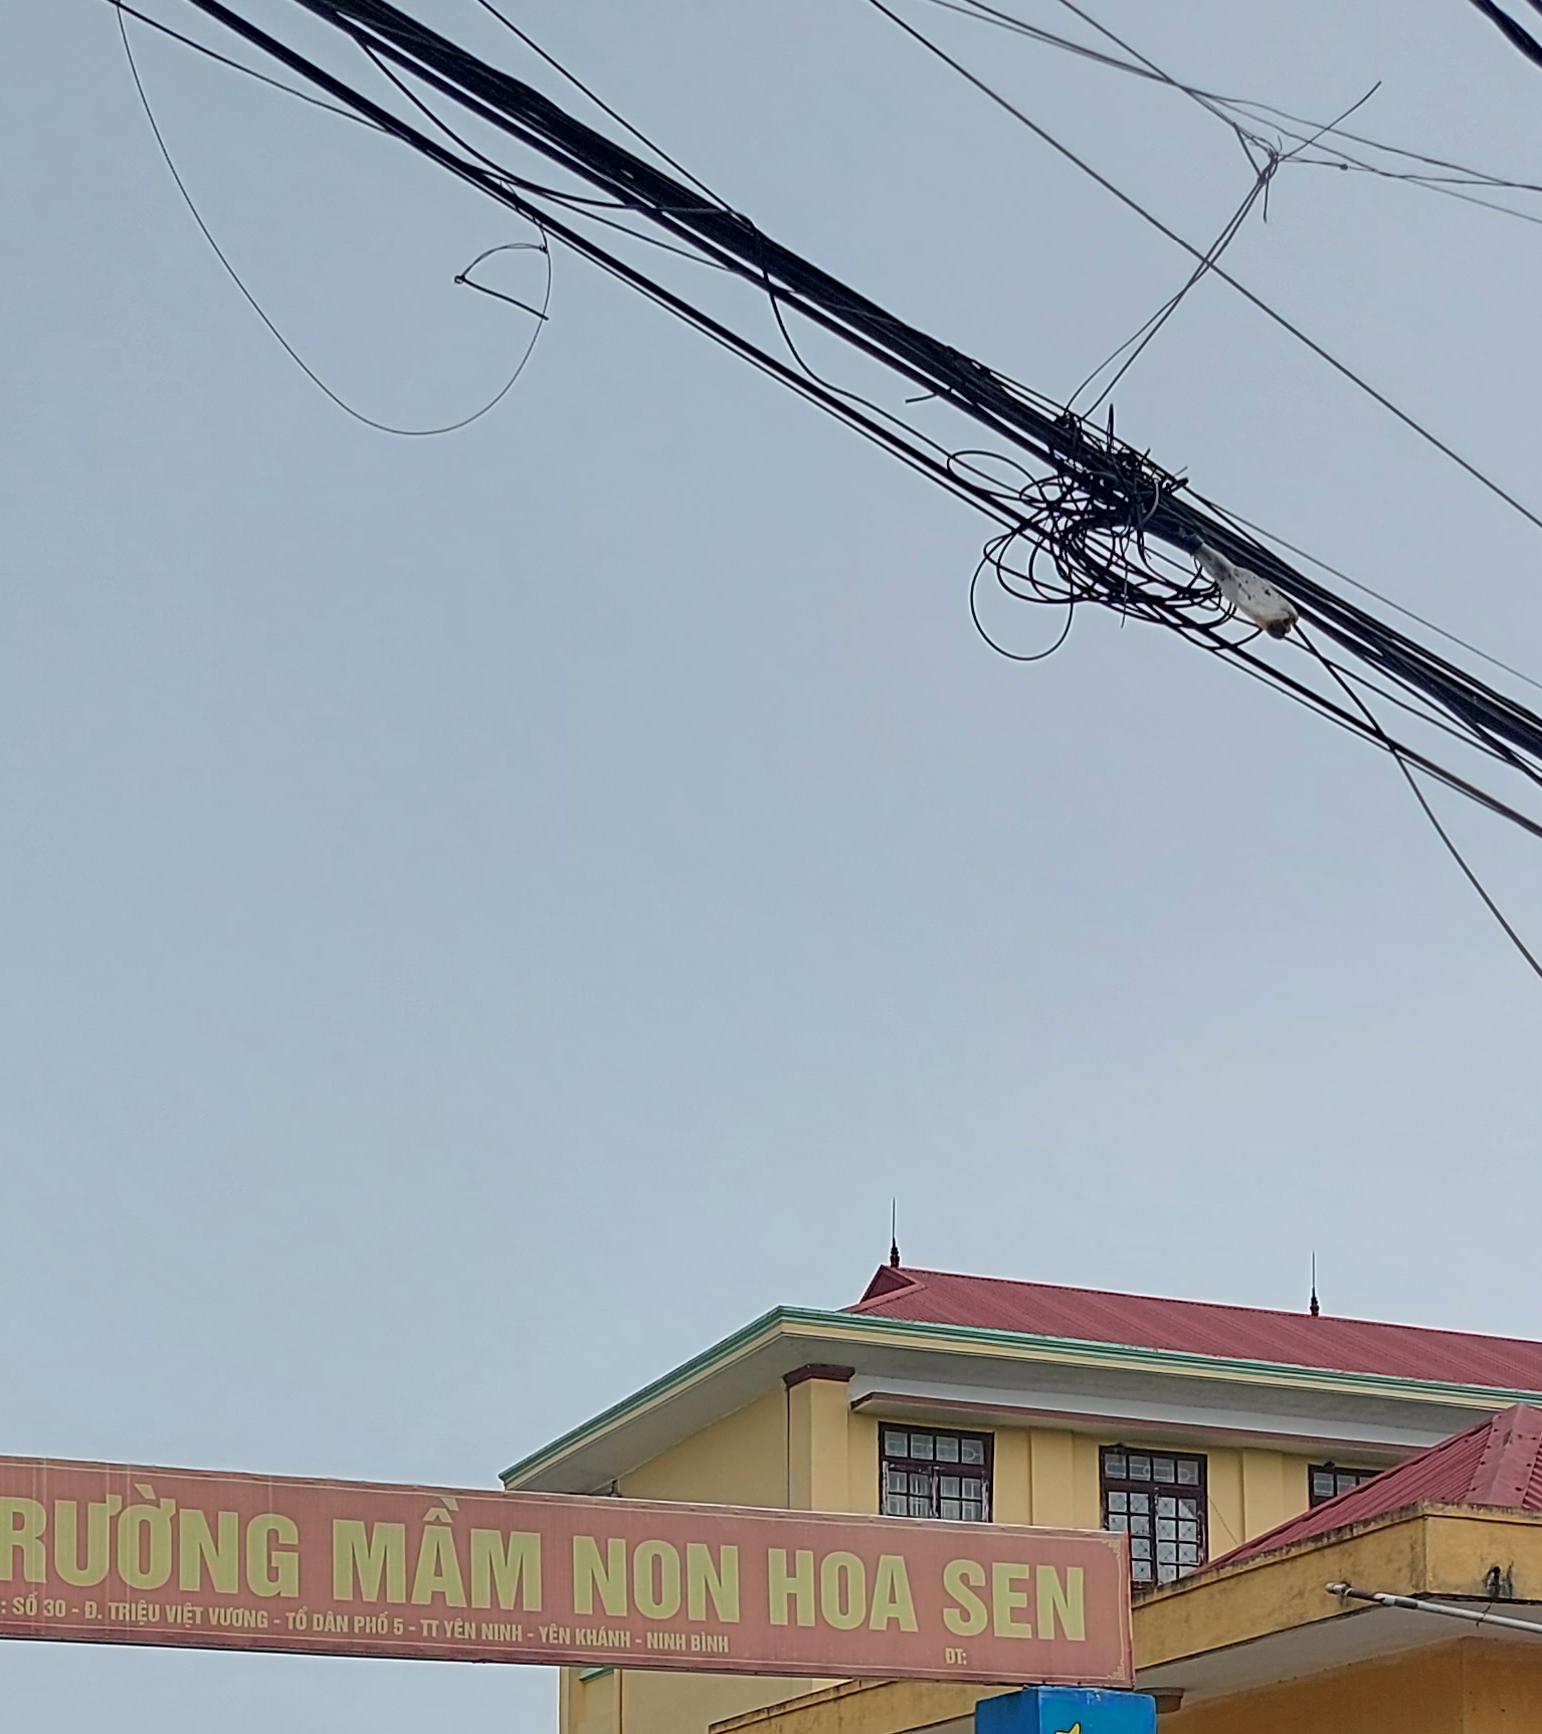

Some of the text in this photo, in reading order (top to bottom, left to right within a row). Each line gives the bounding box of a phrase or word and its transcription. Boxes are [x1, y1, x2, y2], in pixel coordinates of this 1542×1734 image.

[331, 1495, 542, 1614] MẦM
[572, 1535, 741, 1624] NON
[767, 1547, 919, 1633] HOA
[941, 1559, 1085, 1642] SEN
[12, 1591, 39, 1616] SỐ
[43, 1599, 66, 1618] 30
[84, 1601, 103, 1620] Đ.
[108, 1600, 160, 1626] TRIỆU
[165, 1602, 204, 1629] VIỆT
[209, 1607, 269, 1629] VƯƠNG
[285, 1606, 309, 1631] TỔ
[312, 1610, 350, 1633] DÂN
[353, 1610, 389, 1635] PHỐ
[393, 1617, 404, 1636] 5
[420, 1618, 440, 1638] TT
[443, 1617, 476, 1640] YÊN
[481, 1622, 522, 1642] NINH
[539, 1622, 571, 1645] YÊN
[575, 1625, 631, 1648] KHÁNH
[646, 1631, 686, 1651] NINH
[690, 1630, 729, 1653] BÌNH
[945, 1647, 967, 1665] ĐT:
